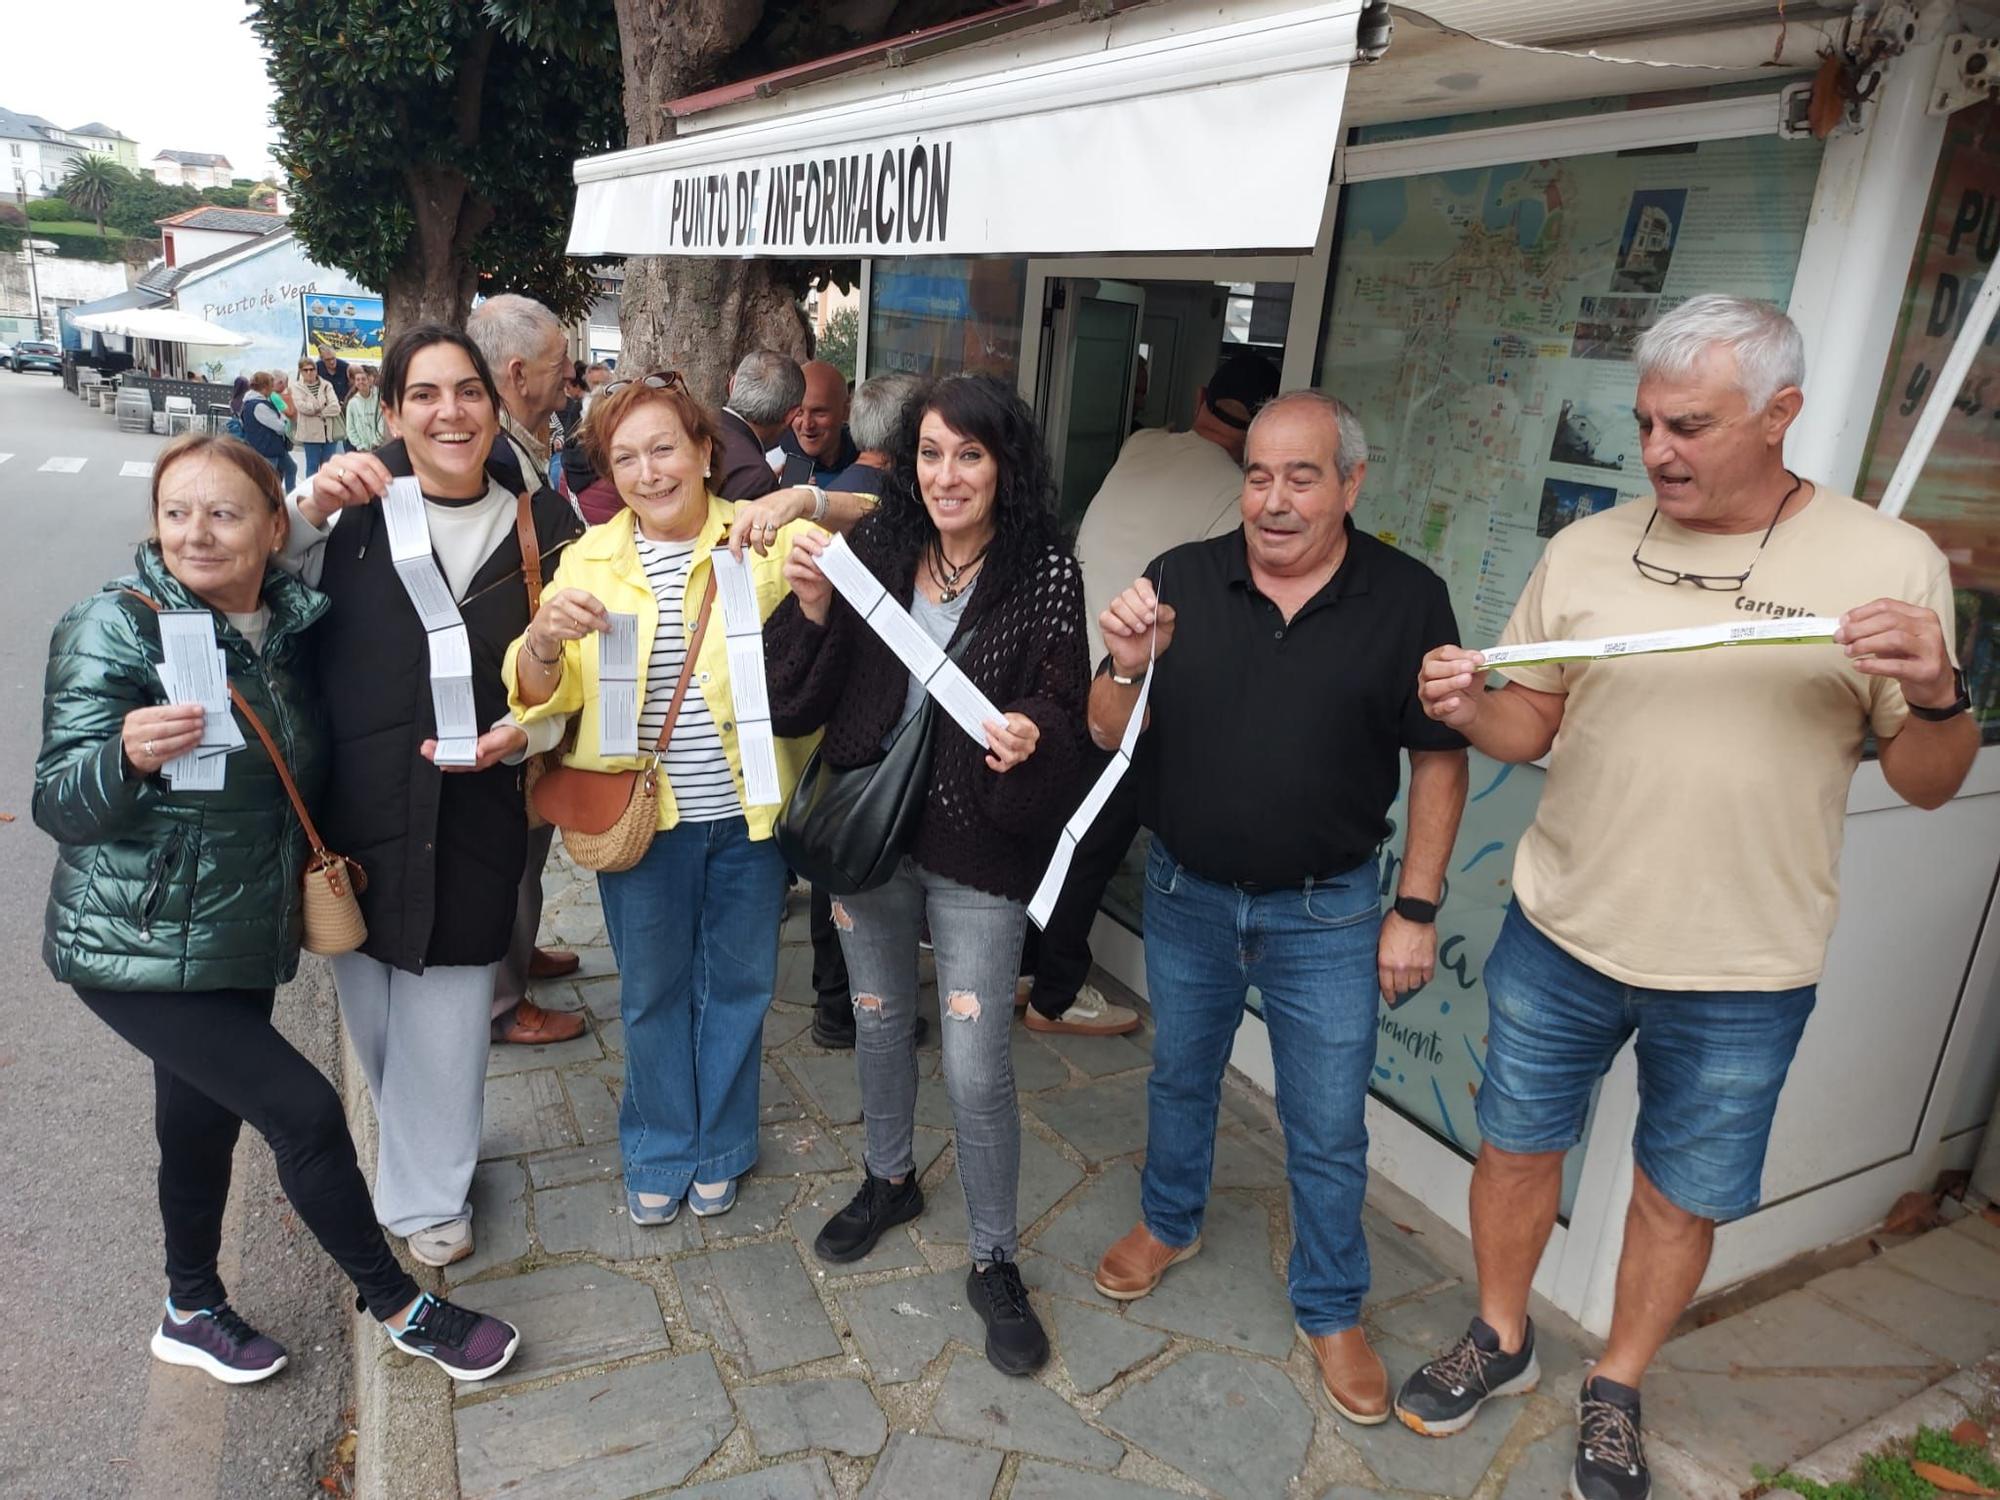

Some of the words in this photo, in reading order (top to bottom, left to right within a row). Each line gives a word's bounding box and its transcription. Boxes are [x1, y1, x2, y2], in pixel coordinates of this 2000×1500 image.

[670, 173, 729, 248] PUNTO
[736, 169, 760, 246] DE
[763, 136, 952, 246] INFORMACIÓN
[203, 296, 256, 321] Puerto
[260, 287, 277, 310] de
